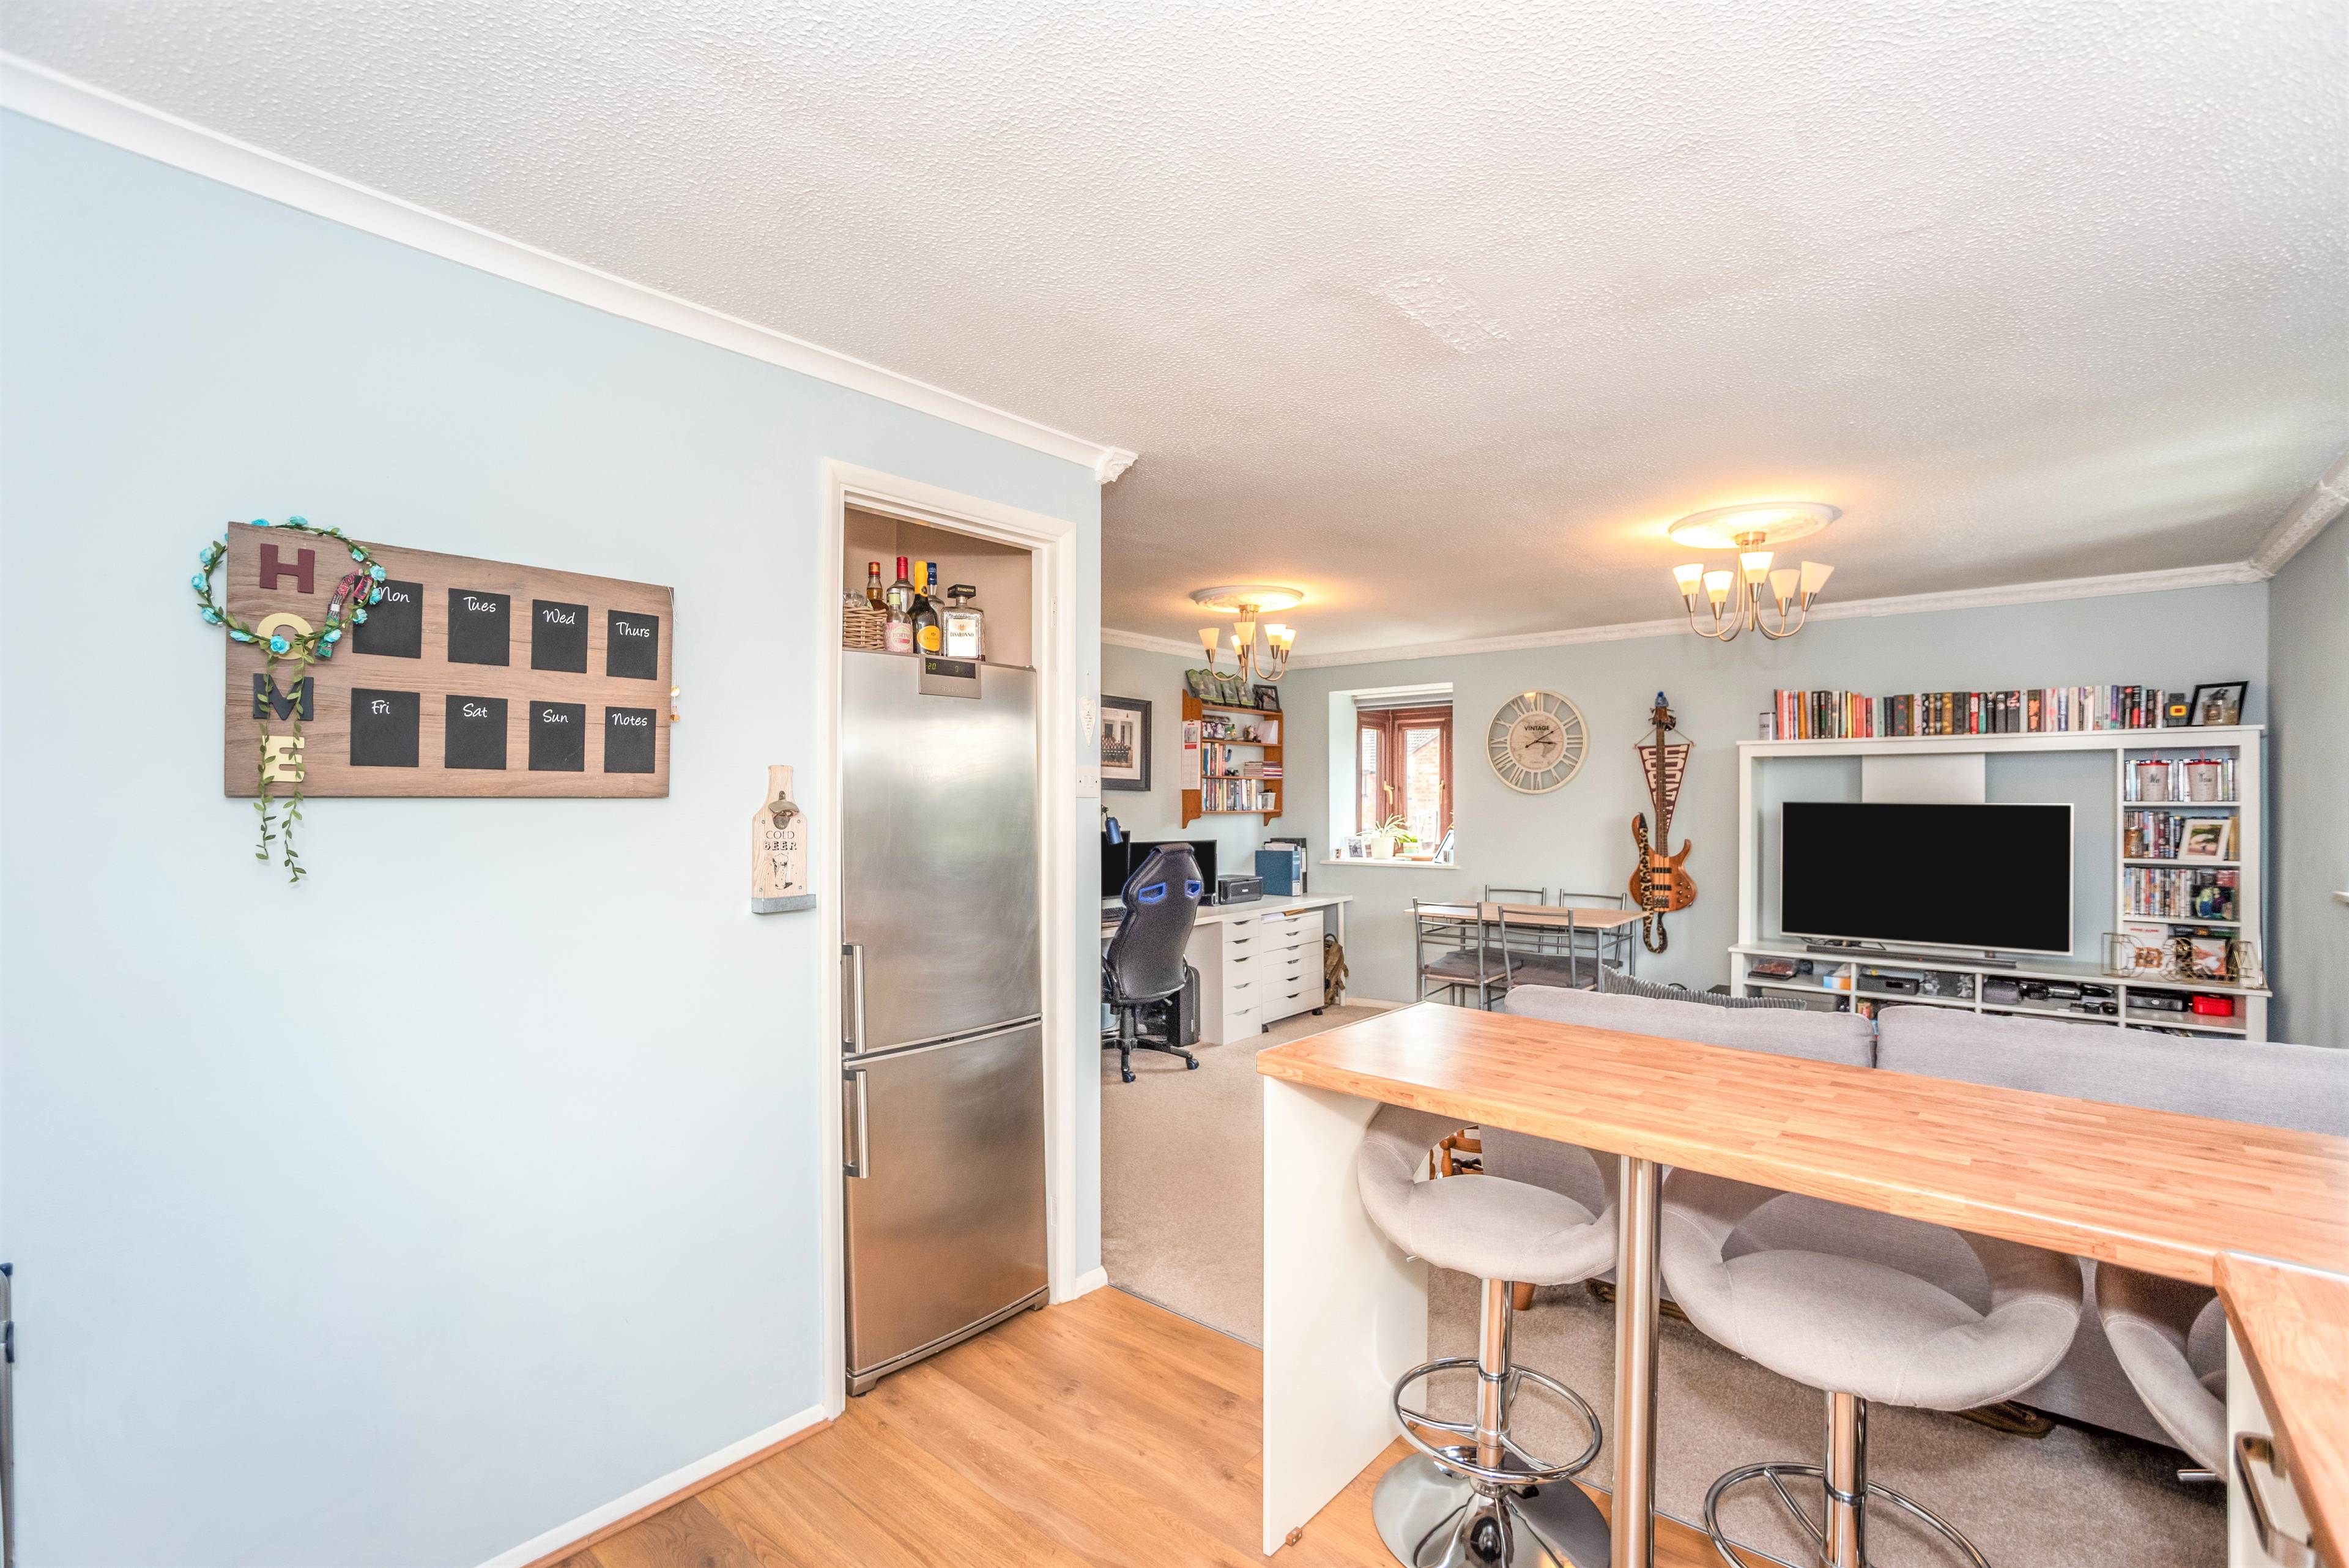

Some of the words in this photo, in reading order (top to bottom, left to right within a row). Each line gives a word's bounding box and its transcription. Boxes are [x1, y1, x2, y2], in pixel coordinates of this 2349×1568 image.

[463, 596, 497, 612] Tues
[543, 609, 575, 625] Wed
[615, 622, 650, 637] Thurs
[371, 700, 390, 714] Fri
[463, 703, 488, 718] Sat
[543, 709, 568, 723] Sun
[612, 713, 648, 726] Notes
[766, 830, 795, 839] COLD
[764, 841, 797, 850] BEER
